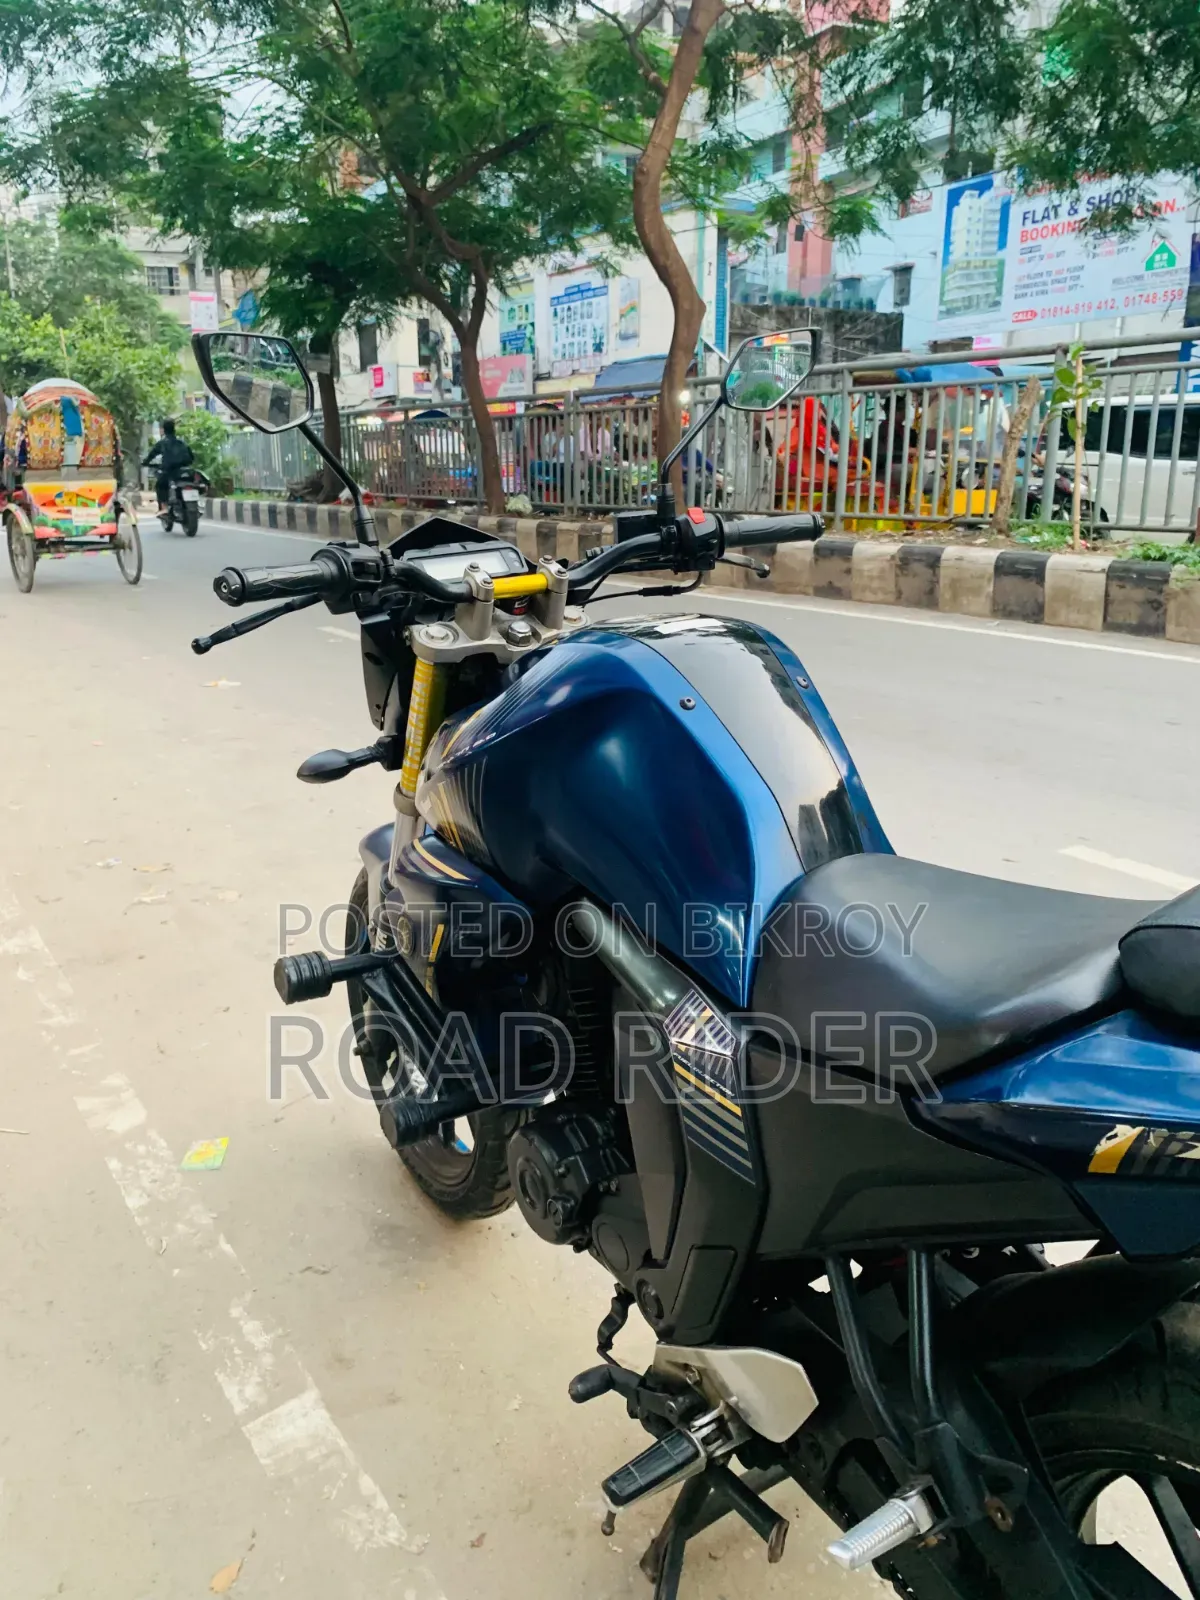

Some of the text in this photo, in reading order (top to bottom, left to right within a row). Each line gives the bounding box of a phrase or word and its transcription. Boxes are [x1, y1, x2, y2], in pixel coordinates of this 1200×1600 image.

[1022, 204, 1062, 227] FLAT
[1067, 200, 1079, 217] &
[1086, 187, 1136, 213] SHOP
